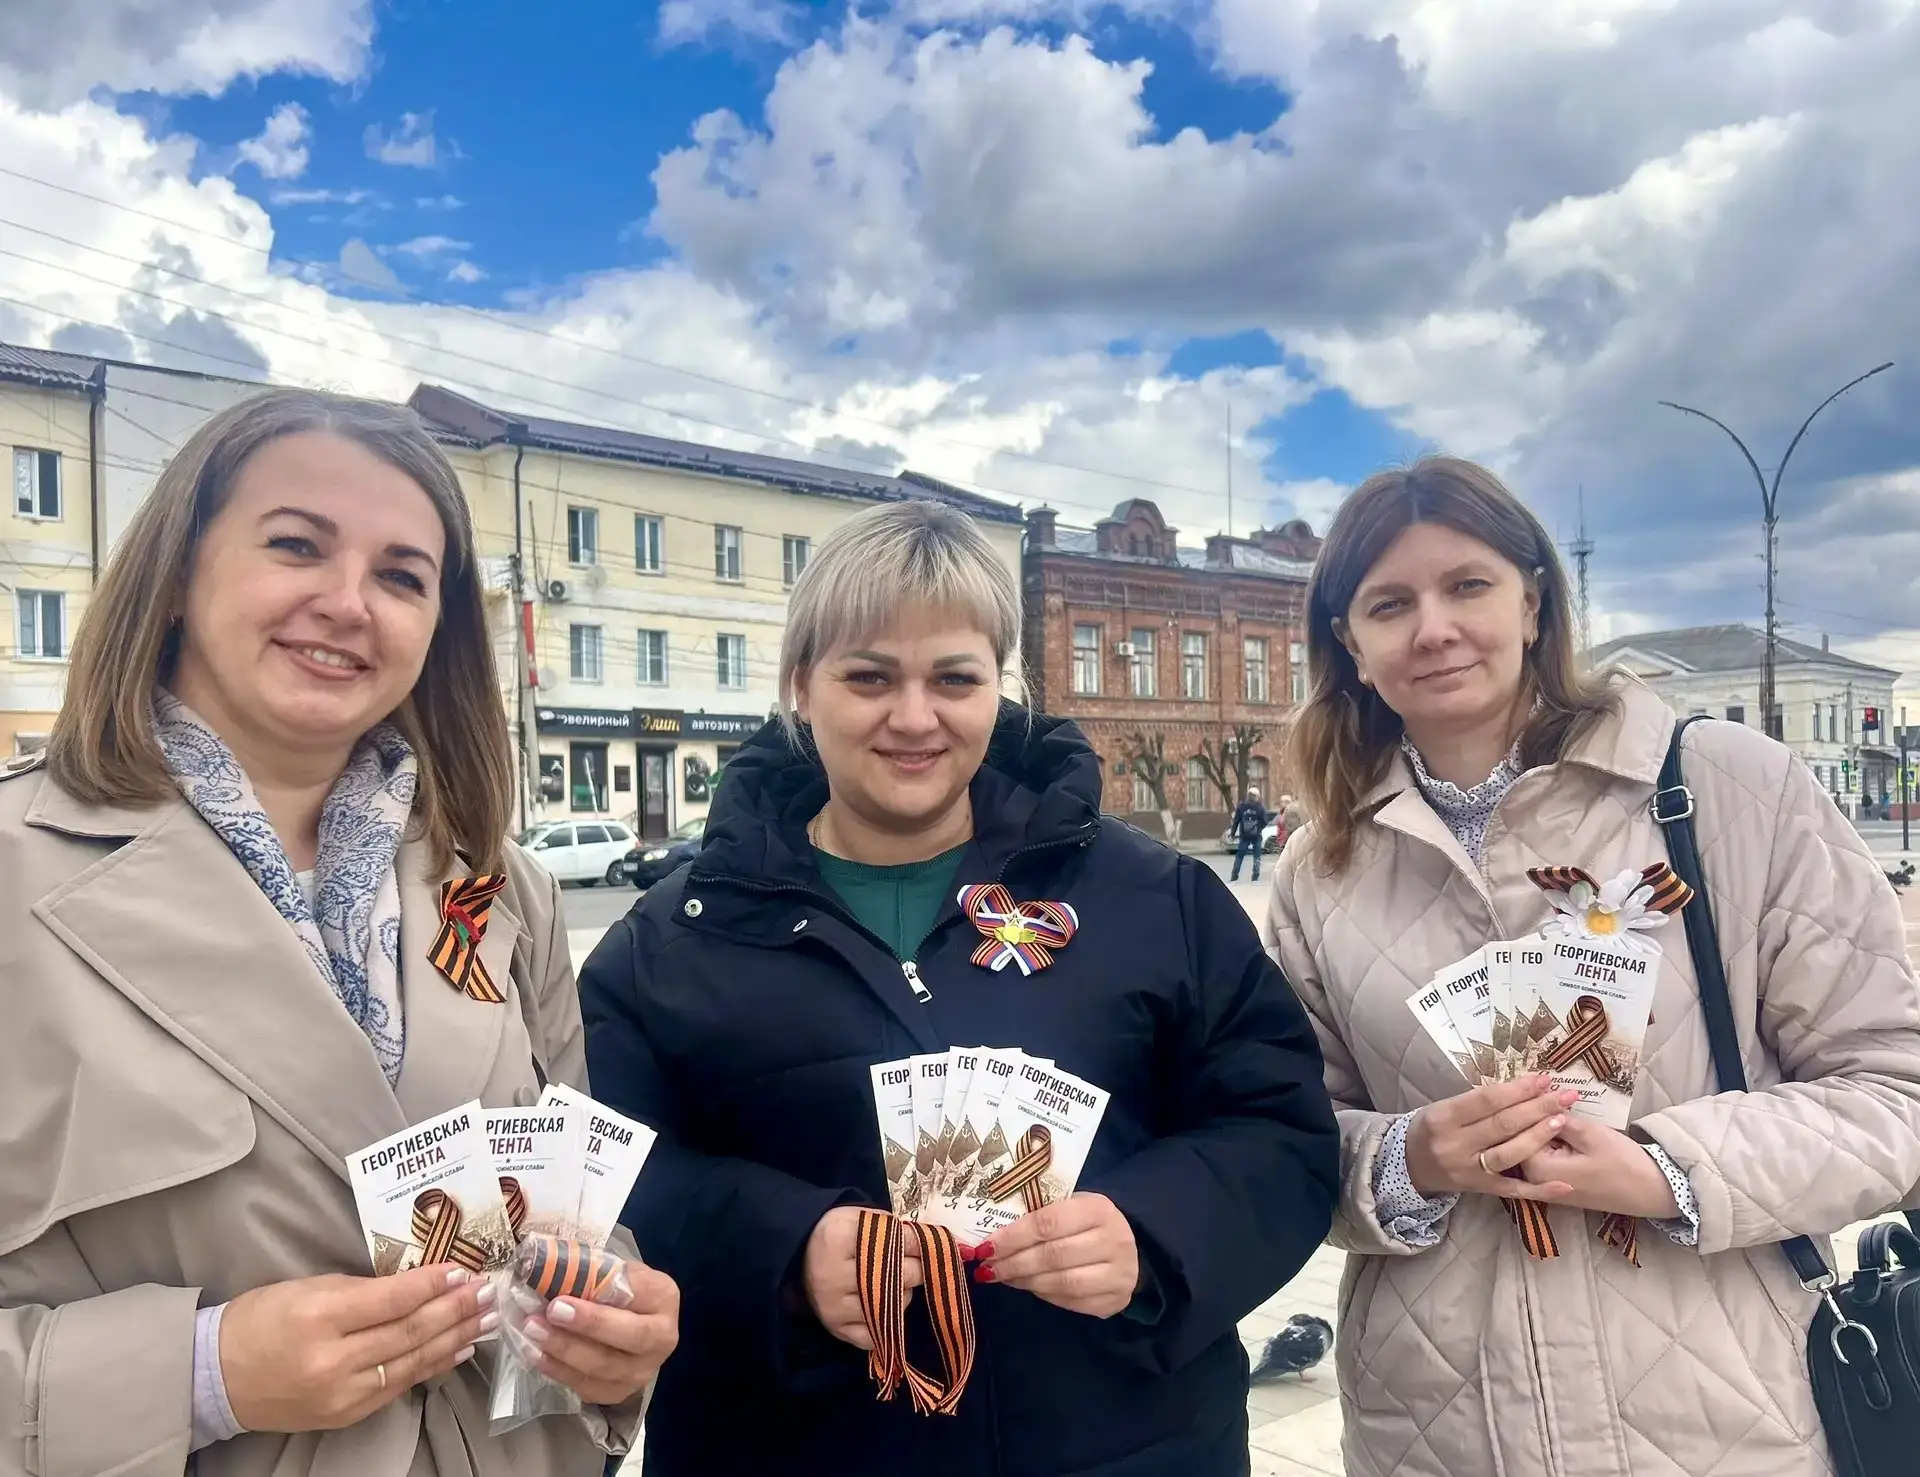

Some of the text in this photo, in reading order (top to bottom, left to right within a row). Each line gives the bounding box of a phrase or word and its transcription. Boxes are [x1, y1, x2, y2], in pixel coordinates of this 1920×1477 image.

[692, 719, 742, 734] автозвук
[1554, 943, 1646, 975] ГЕОРГИЕВСКАЯ
[1574, 963, 1617, 984] ЛЕНТА
[1559, 981, 1581, 991] СИМВОЛ
[1020, 1064, 1097, 1109] ГЕОРГИЕВСКАЯ
[1034, 1088, 1070, 1115] ЛЕНТА
[361, 1114, 471, 1175] ГЕОРГИЕВСКАЯ
[396, 1146, 446, 1181] ЛЕНТА
[385, 1187, 411, 1203] СИМВОЛ
[968, 1198, 987, 1212] Я
[976, 1215, 993, 1228] Я
